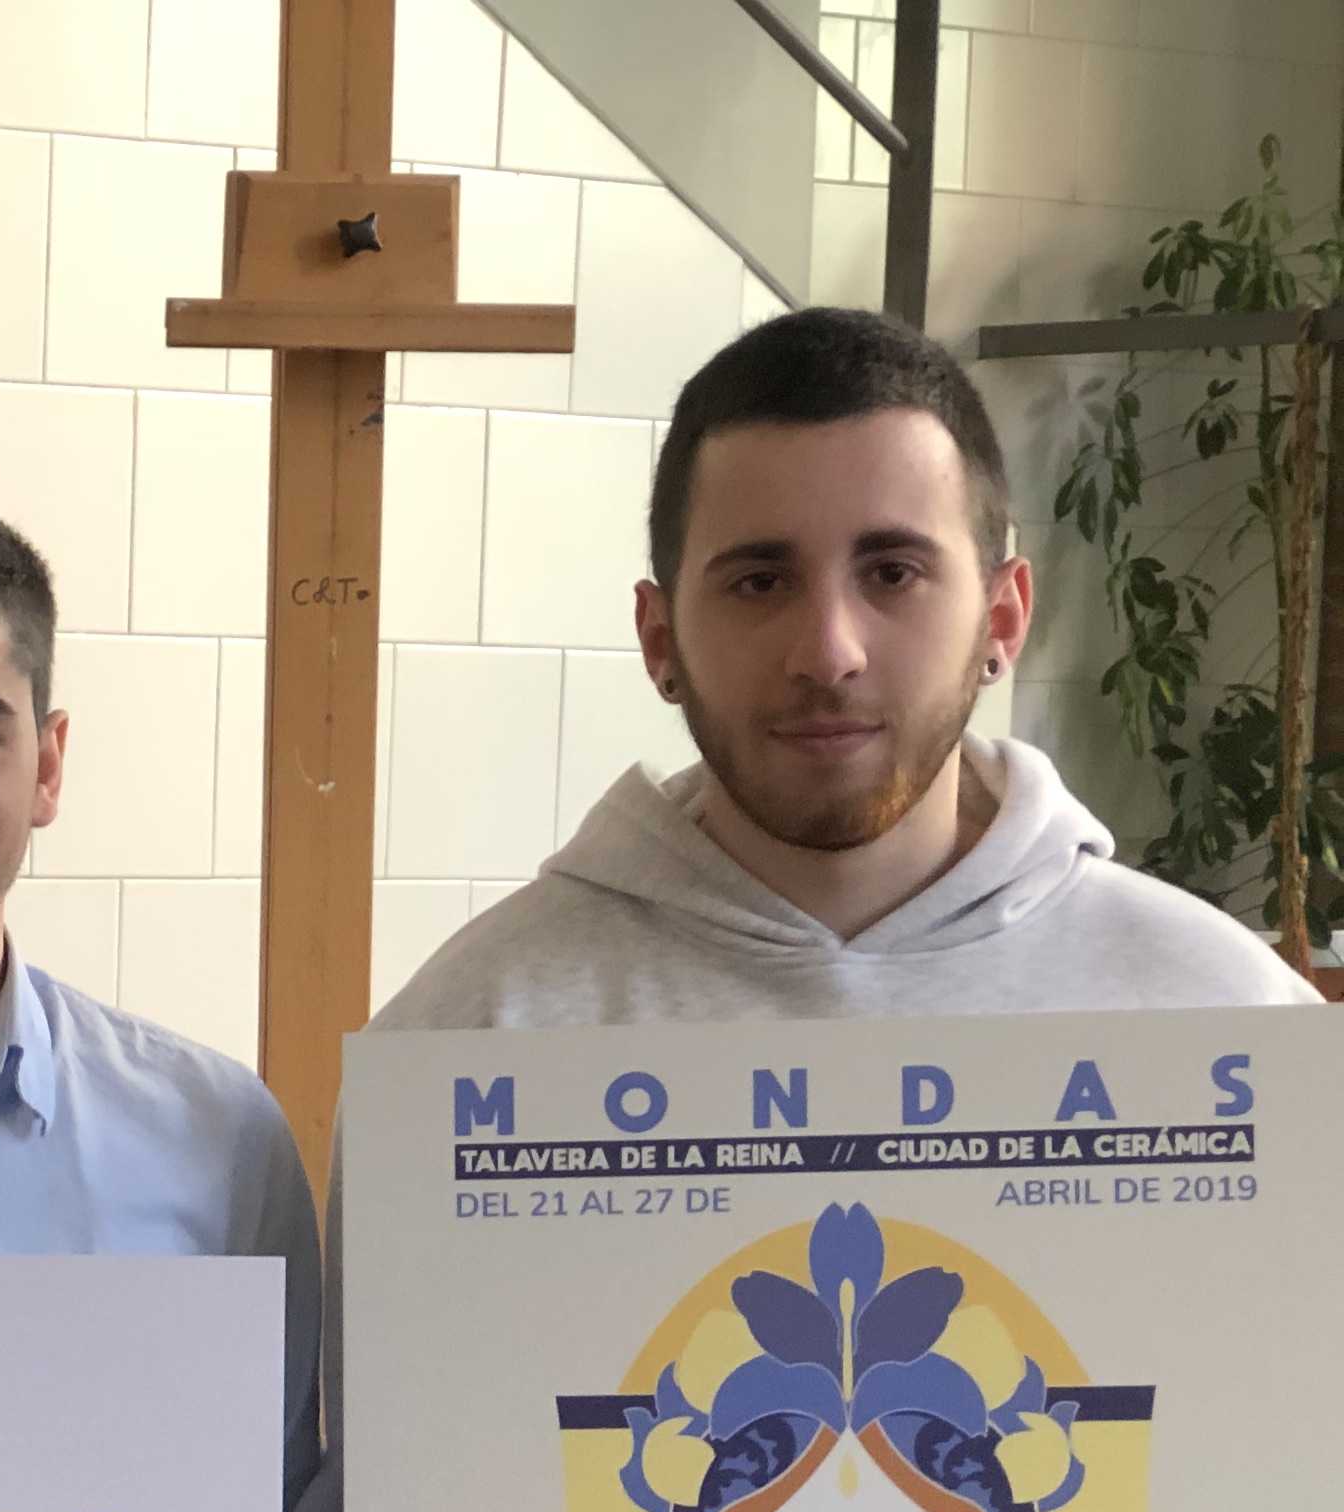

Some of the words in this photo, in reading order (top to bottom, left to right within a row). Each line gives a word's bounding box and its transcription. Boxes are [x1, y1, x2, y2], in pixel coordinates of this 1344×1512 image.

[454, 1054, 1254, 1136] MONDAS
[460, 1148, 610, 1173] TALAVERA
[620, 1146, 657, 1170] DE
[667, 1145, 705, 1169] LA
[716, 1142, 804, 1167] REINA
[877, 1136, 988, 1164] CIUDAD
[998, 1136, 1035, 1161] DE
[1044, 1135, 1083, 1159] LA
[1093, 1127, 1251, 1159] CERÁMICA
[456, 1192, 518, 1218] DEL
[530, 1191, 568, 1217] 21
[580, 1190, 623, 1216] AL
[635, 1189, 674, 1214] 27
[686, 1187, 730, 1213] DE
[995, 1178, 1102, 1206] ABRIL
[1114, 1177, 1160, 1204] DE
[1173, 1175, 1258, 1202] 2019
